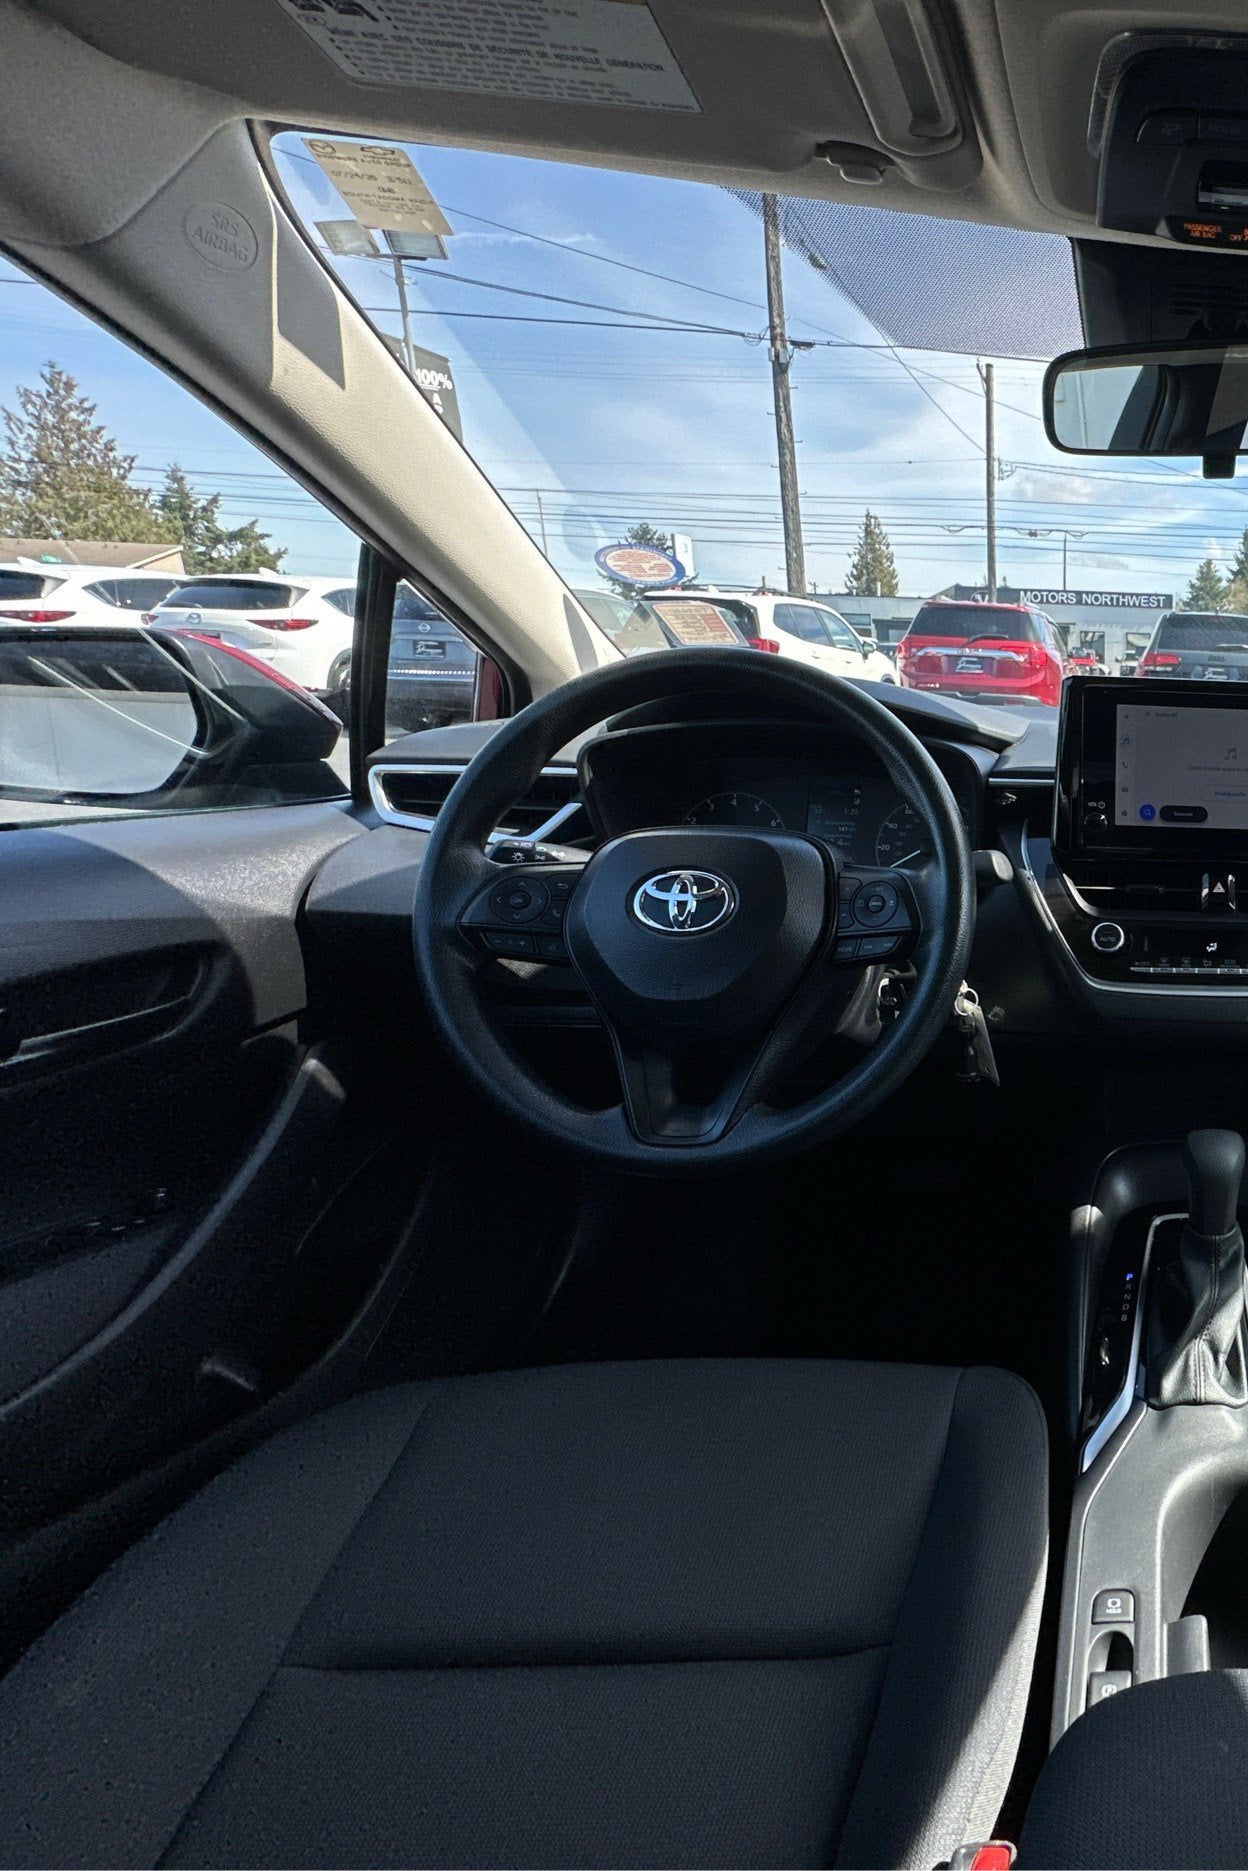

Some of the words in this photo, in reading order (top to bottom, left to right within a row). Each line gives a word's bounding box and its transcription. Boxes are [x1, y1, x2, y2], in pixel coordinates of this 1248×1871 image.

[209, 212, 239, 238] SRS
[192, 226, 248, 263] AIRBAG
[415, 368, 453, 390] 100%
[1020, 590, 1077, 604] MOTORS
[1082, 593, 1166, 608] NORTHWEST
[730, 798, 737, 806] 4
[709, 803, 715, 811] 3
[754, 804, 760, 812] 5
[691, 816, 697, 825] 2
[771, 819, 777, 827] 6
[881, 843, 891, 851] 20
[1125, 1273, 1134, 1281] P
[1123, 1293, 1131, 1301] N
